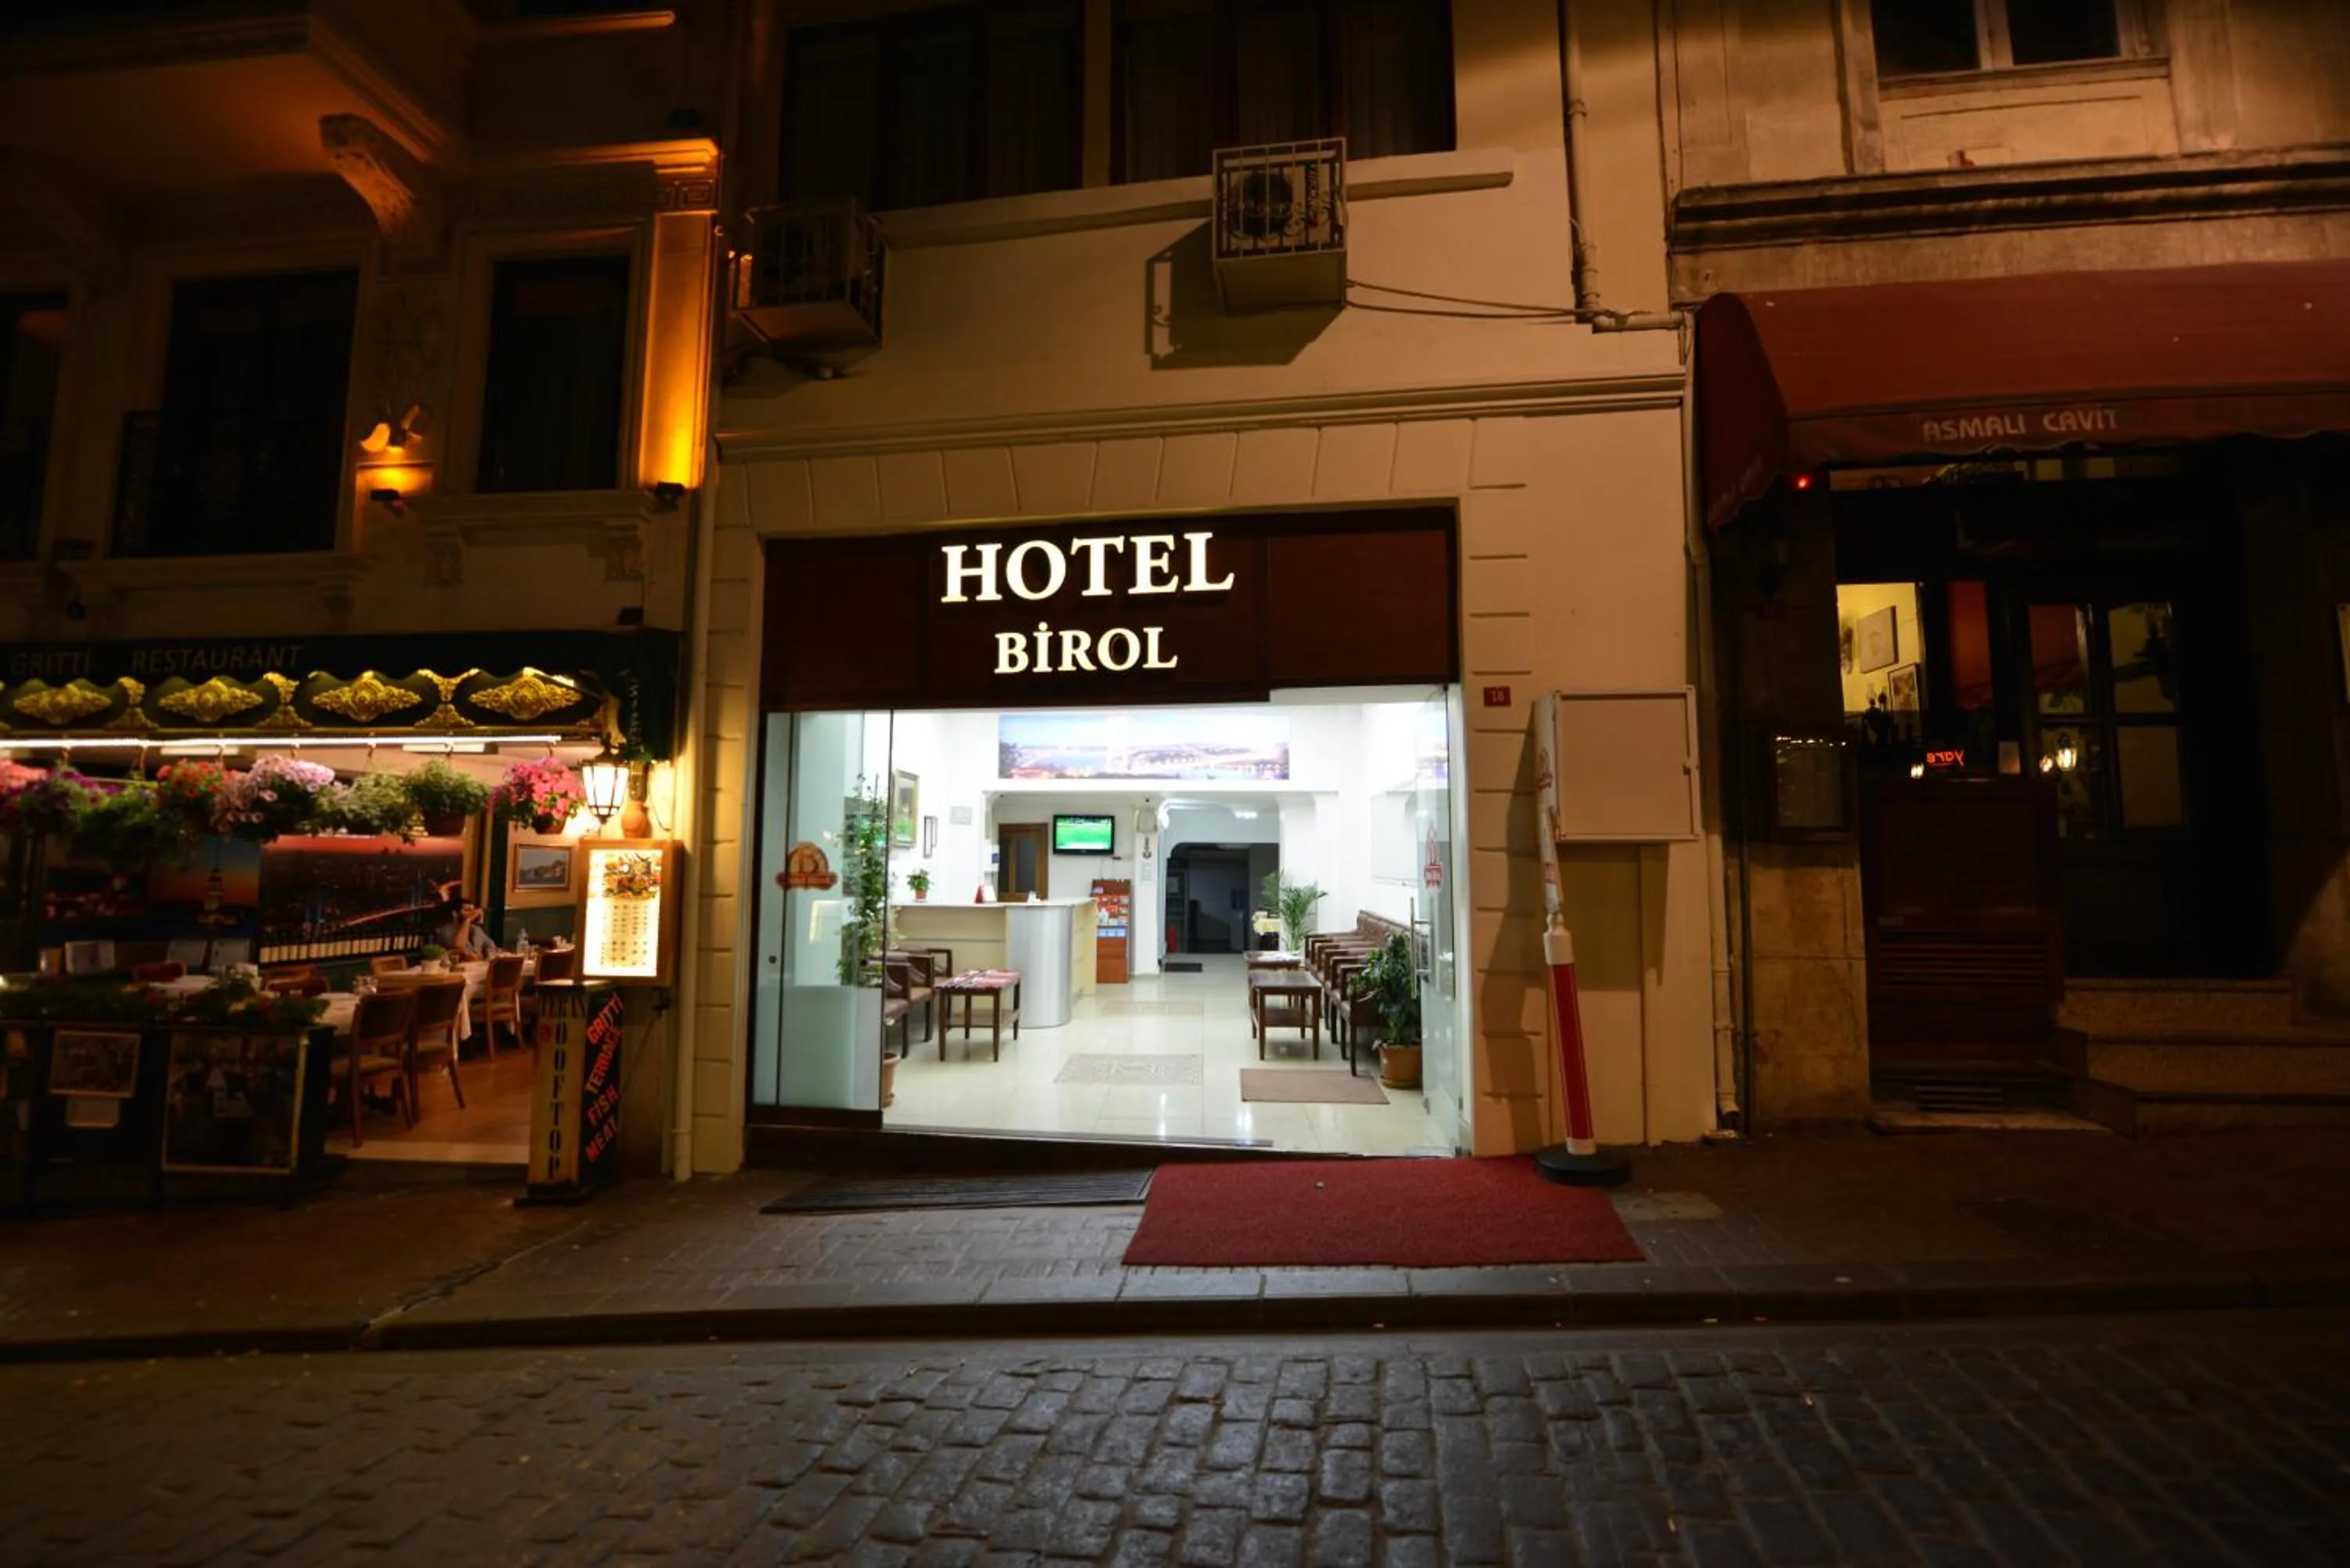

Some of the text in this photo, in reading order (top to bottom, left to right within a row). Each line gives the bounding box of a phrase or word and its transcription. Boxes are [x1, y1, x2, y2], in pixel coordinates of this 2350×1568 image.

[1922, 412, 2026, 443] ASMALI
[942, 532, 1235, 603] HOTEL
[132, 643, 304, 674] RESTAURANT
[587, 992, 624, 1045] GRITTI
[588, 1084, 621, 1126] FISH
